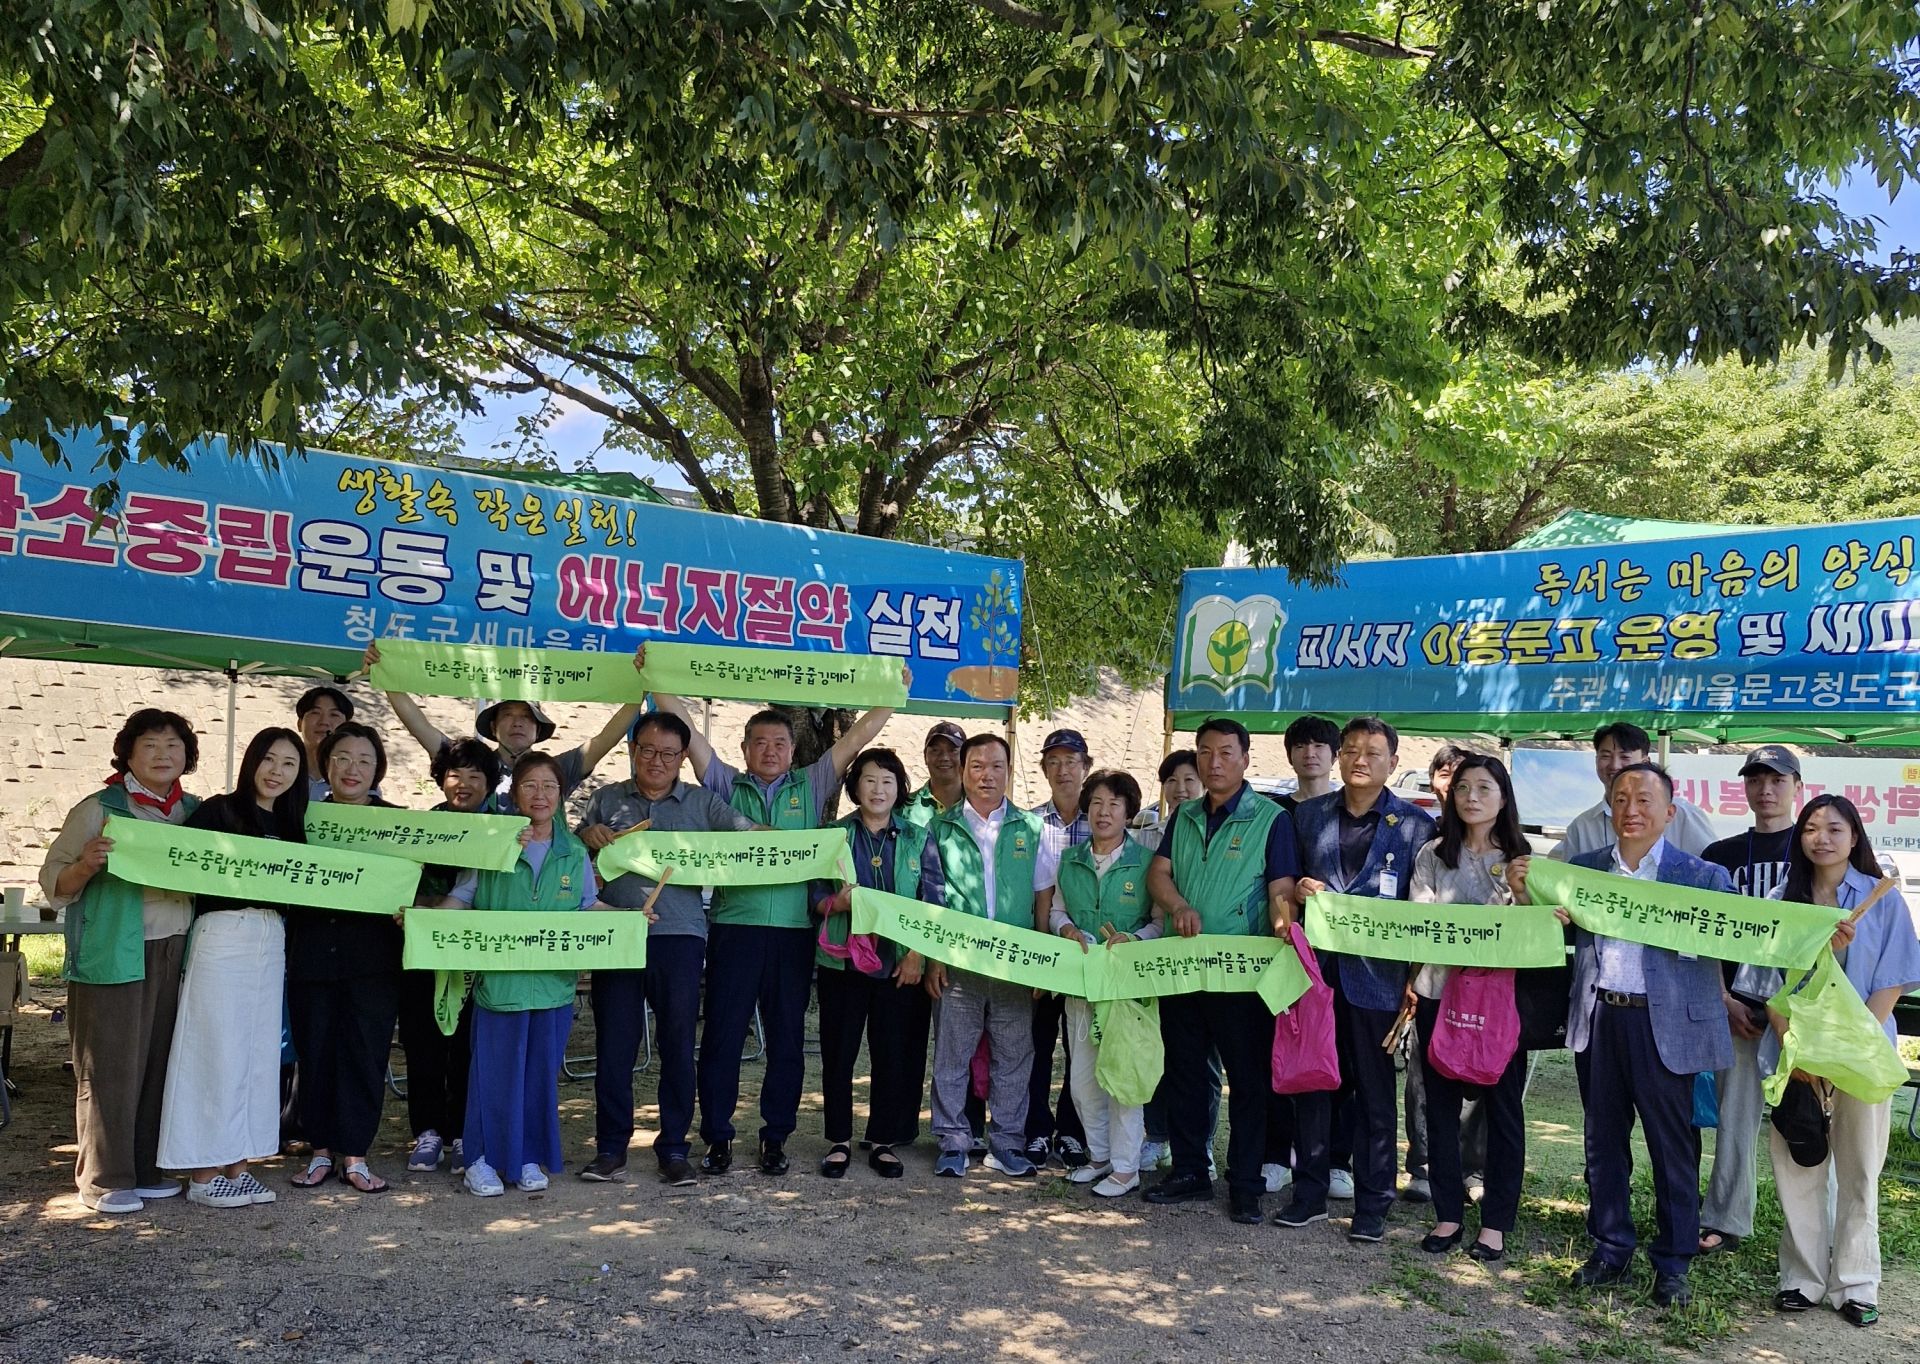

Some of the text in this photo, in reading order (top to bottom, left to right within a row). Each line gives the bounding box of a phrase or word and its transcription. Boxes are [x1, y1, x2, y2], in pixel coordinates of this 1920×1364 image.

[337, 466, 458, 526] 생활속
[1535, 536, 1914, 607] 독서는 마음의 양식
[475, 550, 533, 616] 및
[556, 553, 851, 652] 에너지절약
[866, 588, 963, 661] 실천
[1296, 621, 1413, 669] 피서지
[1420, 615, 1602, 668] 이동문고
[1614, 609, 1723, 664] 운영
[1738, 612, 1786, 657] 및
[1548, 677, 1606, 708] 주관
